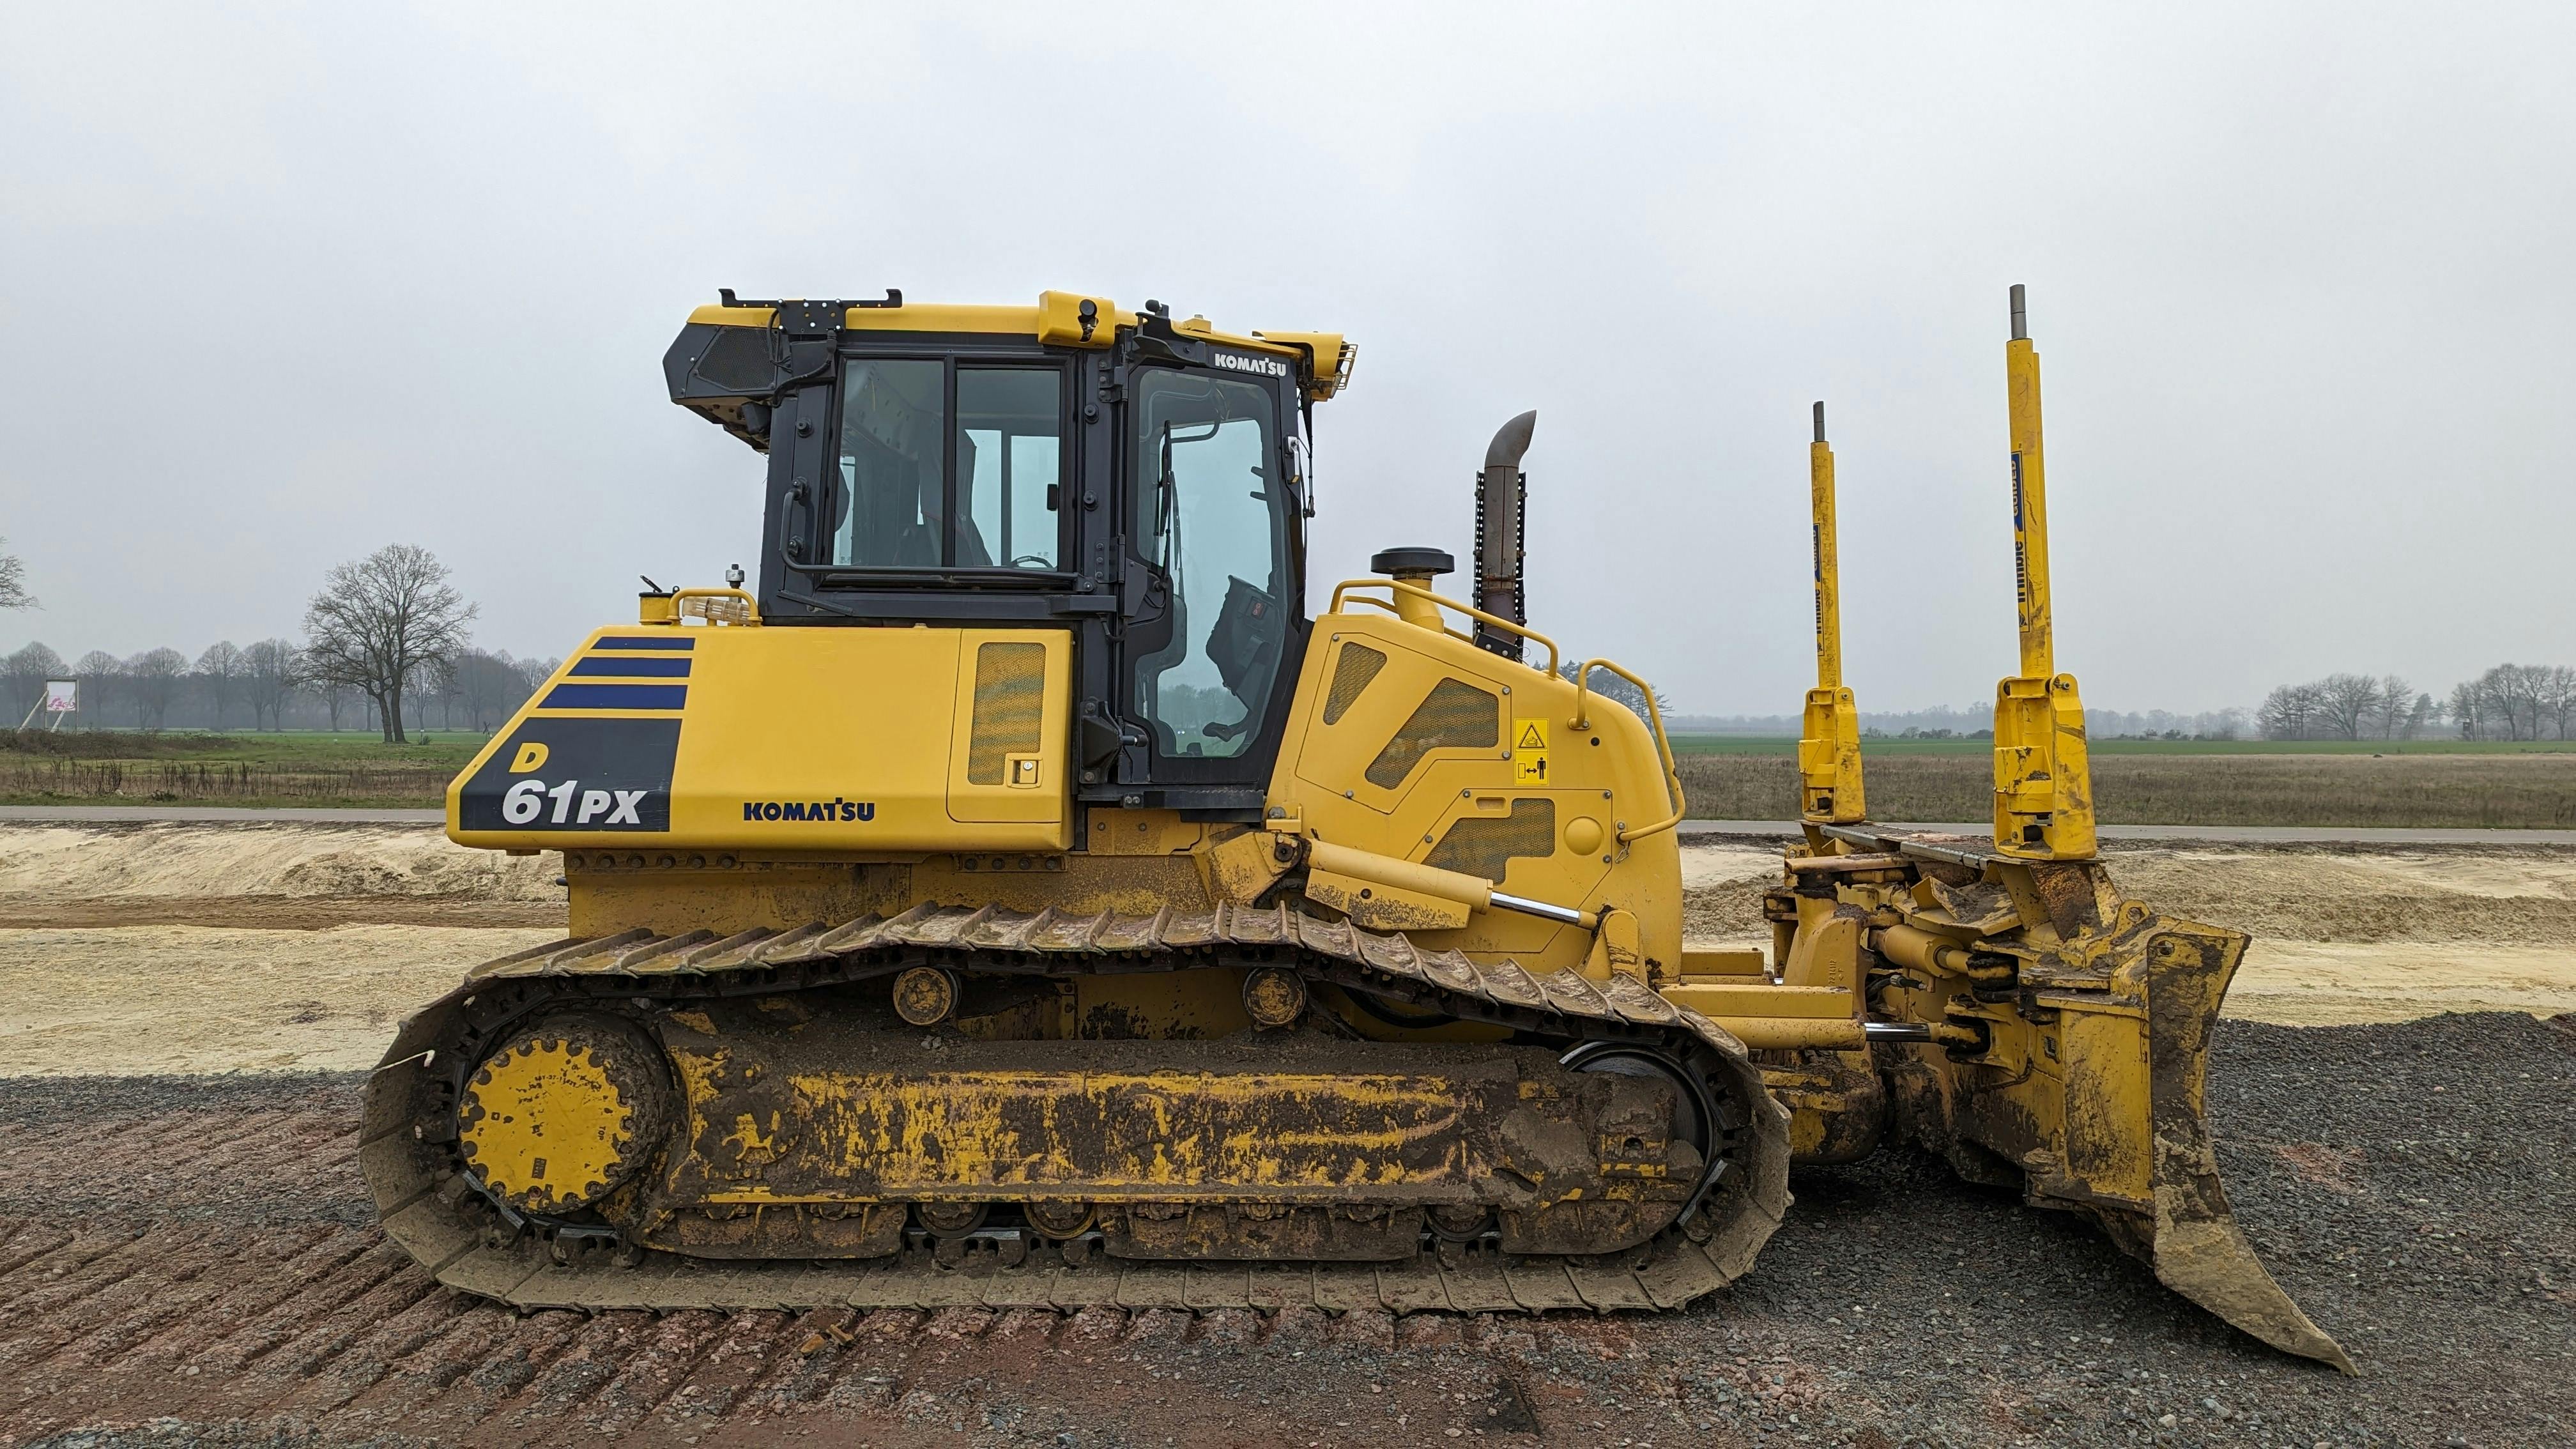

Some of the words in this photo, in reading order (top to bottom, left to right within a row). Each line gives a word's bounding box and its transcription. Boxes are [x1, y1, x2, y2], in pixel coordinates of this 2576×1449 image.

[1215, 353, 1286, 377] KOMATSU
[509, 742, 549, 773] D
[744, 797, 875, 822] KOMATSU
[598, 1126, 606, 1140] TOP
